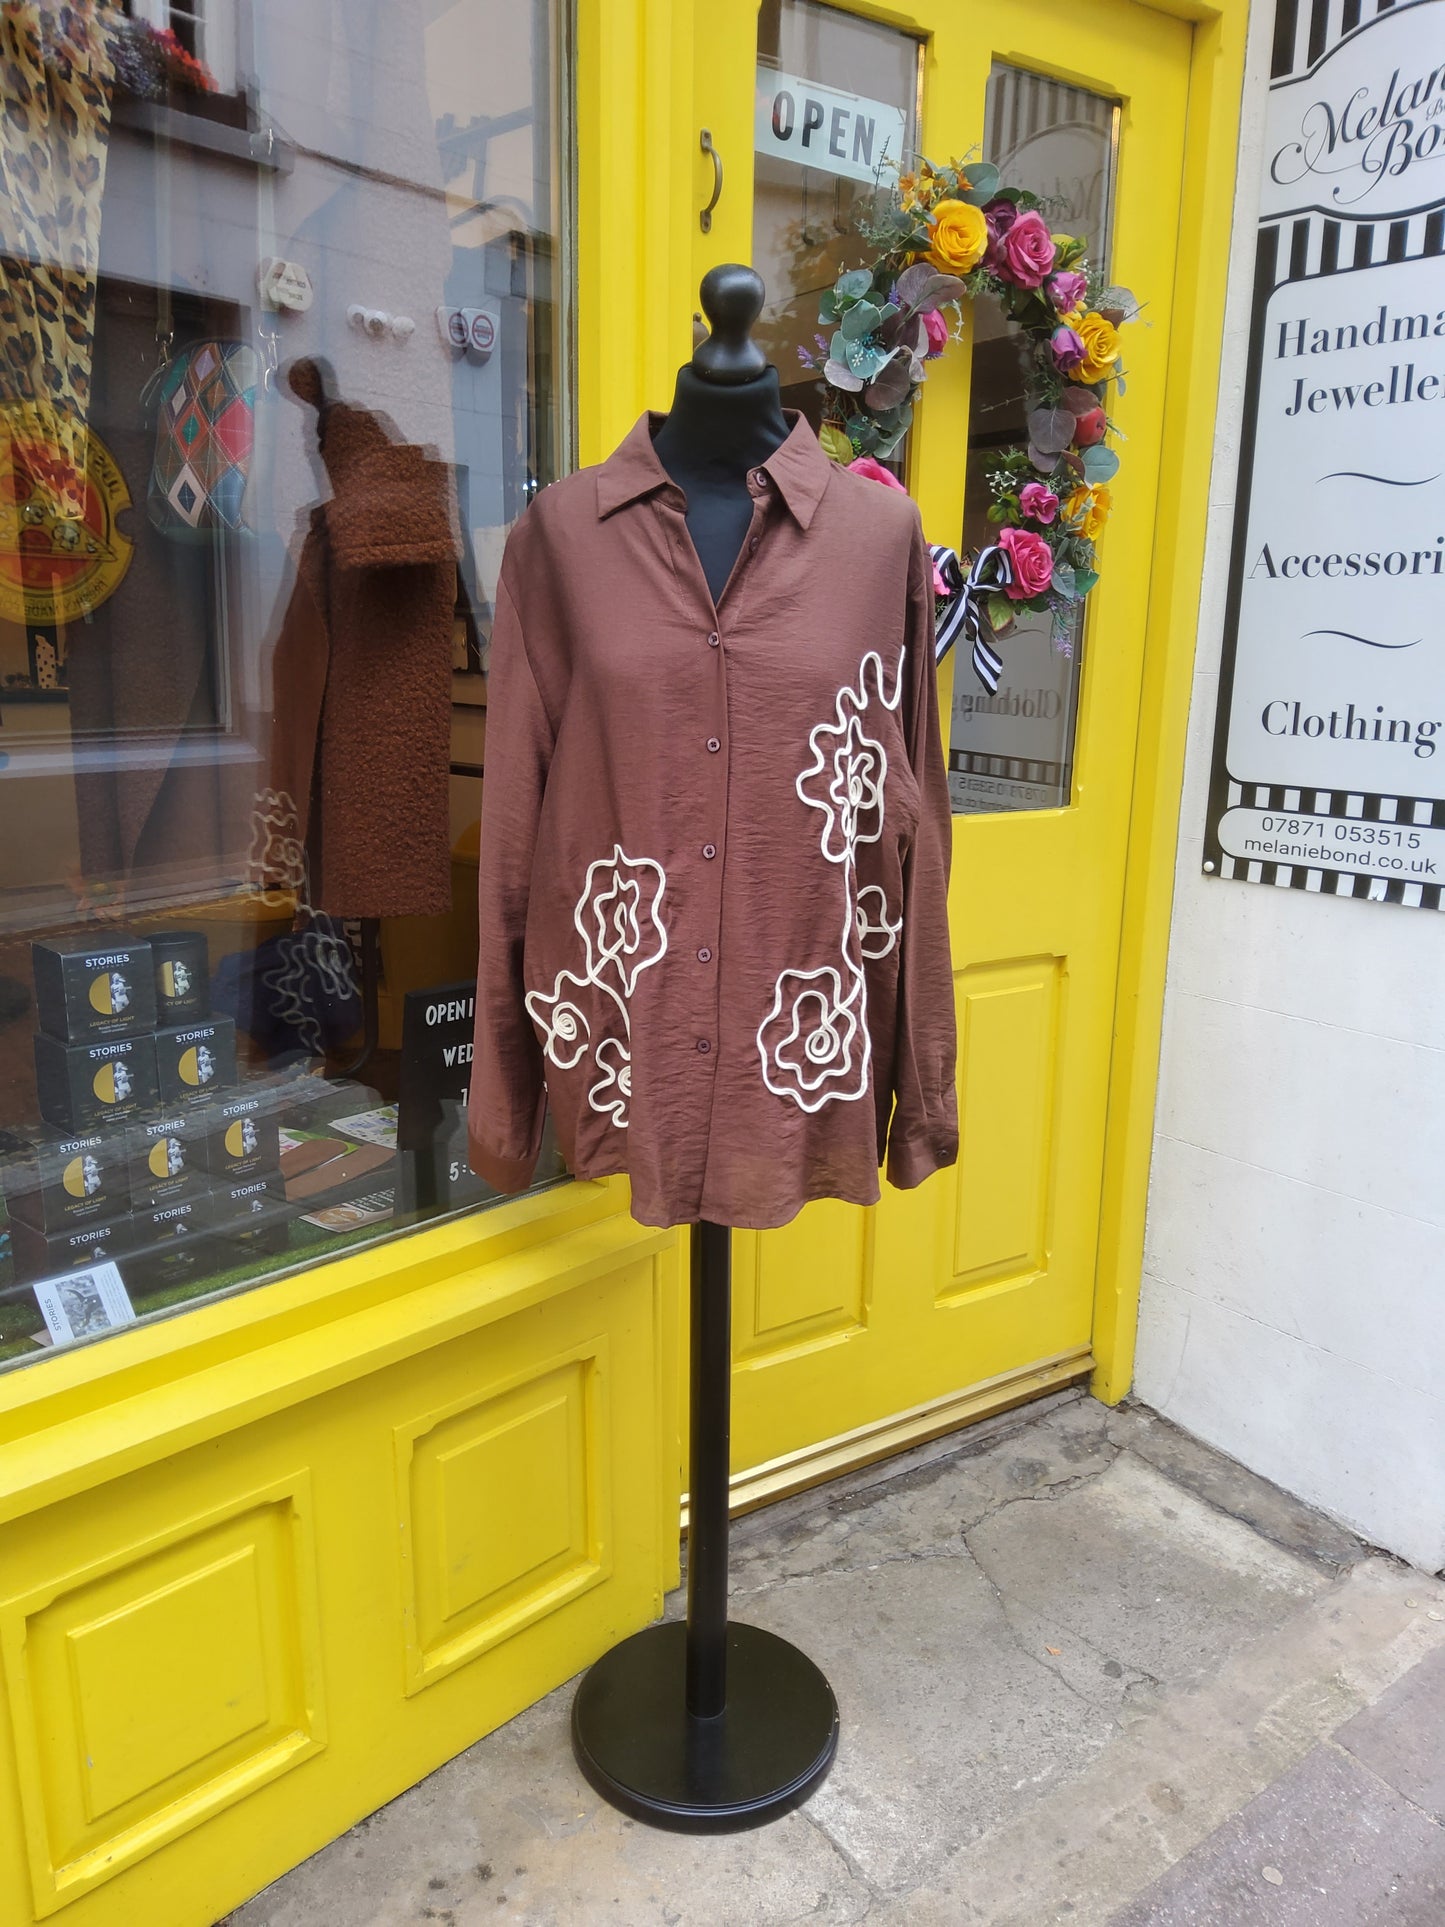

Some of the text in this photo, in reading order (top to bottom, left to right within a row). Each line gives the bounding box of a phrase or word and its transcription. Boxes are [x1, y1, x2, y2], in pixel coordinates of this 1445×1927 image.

[772, 91, 876, 166] OPEN
[1285, 363, 1445, 417] Jewelle
[1247, 536, 1445, 579] Accessori
[1261, 700, 1442, 758] Clothing
[1262, 817, 1421, 849] 07871 053515
[1245, 839, 1437, 875] melaniebond.co.uk
[85, 954, 130, 968] STORIES
[176, 1027, 215, 1043] STORIES
[89, 1043, 133, 1058] STORIES
[223, 1100, 259, 1116] STORIES
[146, 1119, 185, 1136] STORIES
[60, 1136, 102, 1153] STORIES
[231, 1181, 267, 1199] STORIES
[153, 1204, 192, 1222] STORIES
[70, 1227, 111, 1246] STORIES
[44, 1298, 62, 1331] STORIES
